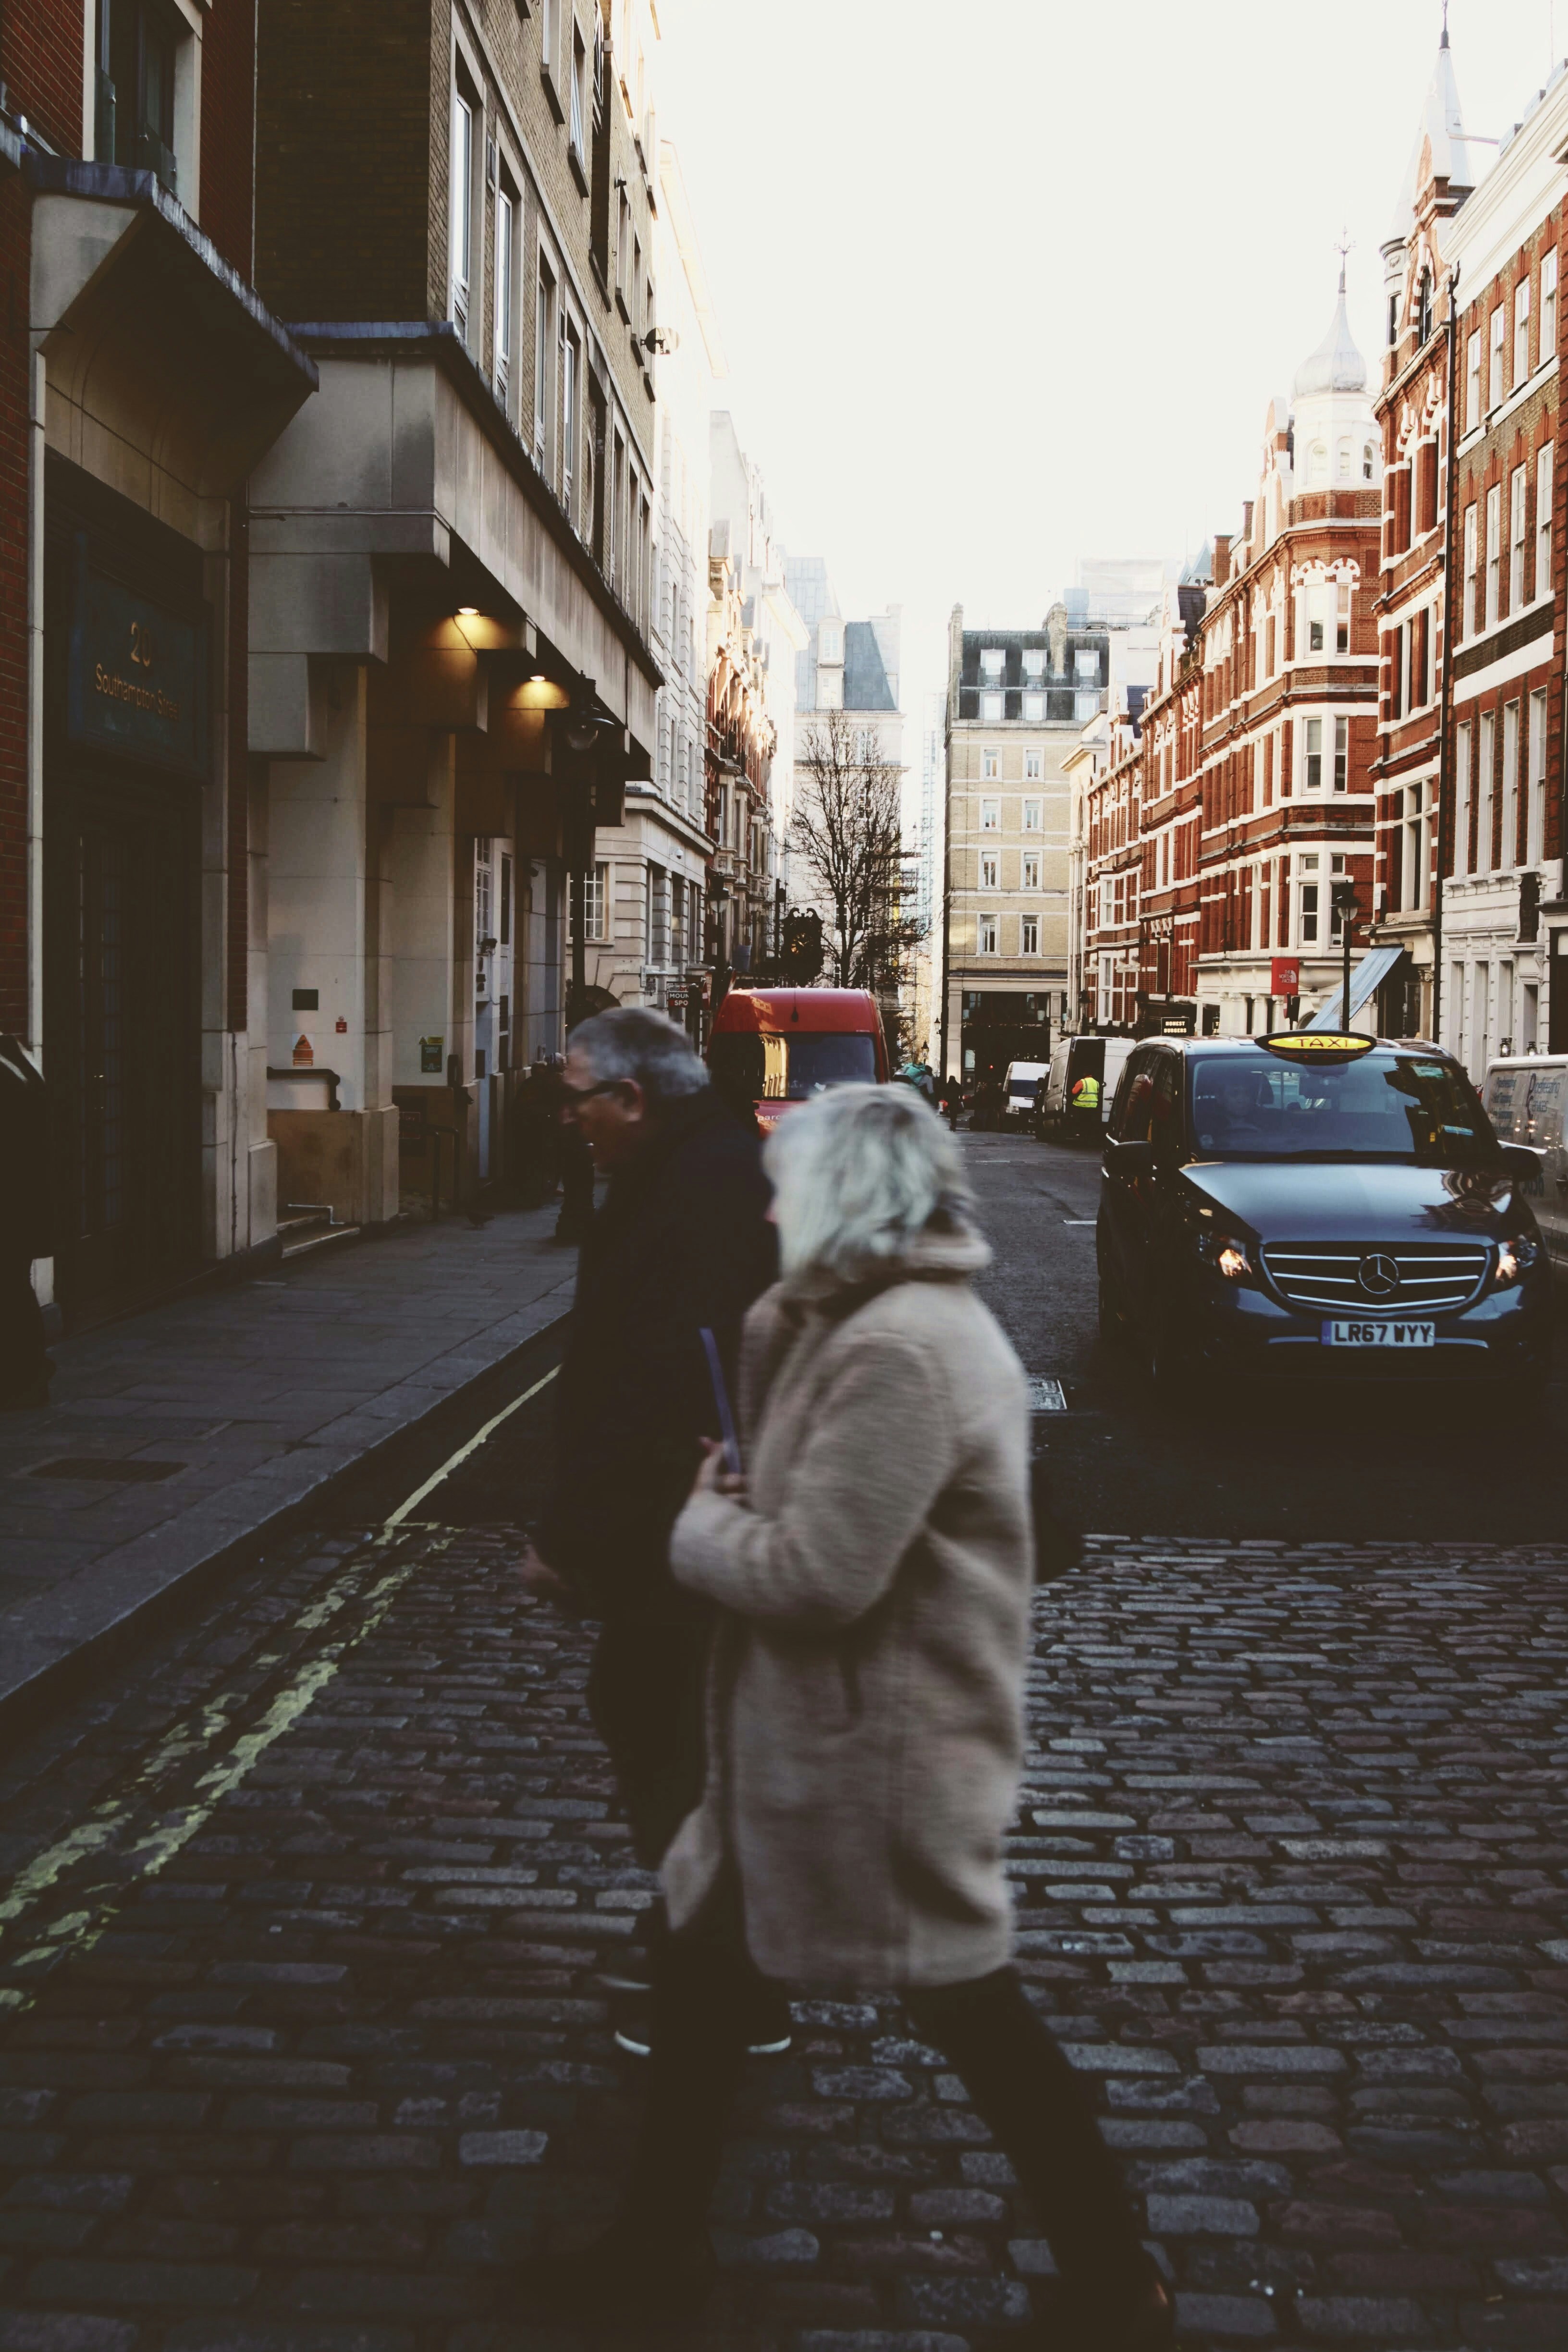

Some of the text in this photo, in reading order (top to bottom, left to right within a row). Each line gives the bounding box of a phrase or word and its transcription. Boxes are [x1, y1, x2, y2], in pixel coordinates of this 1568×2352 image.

[130, 622, 151, 667] 20
[96, 662, 155, 711] Southampton
[1296, 1038, 1348, 1048] TAXI
[1335, 1323, 1432, 1343] LR67 WYY
